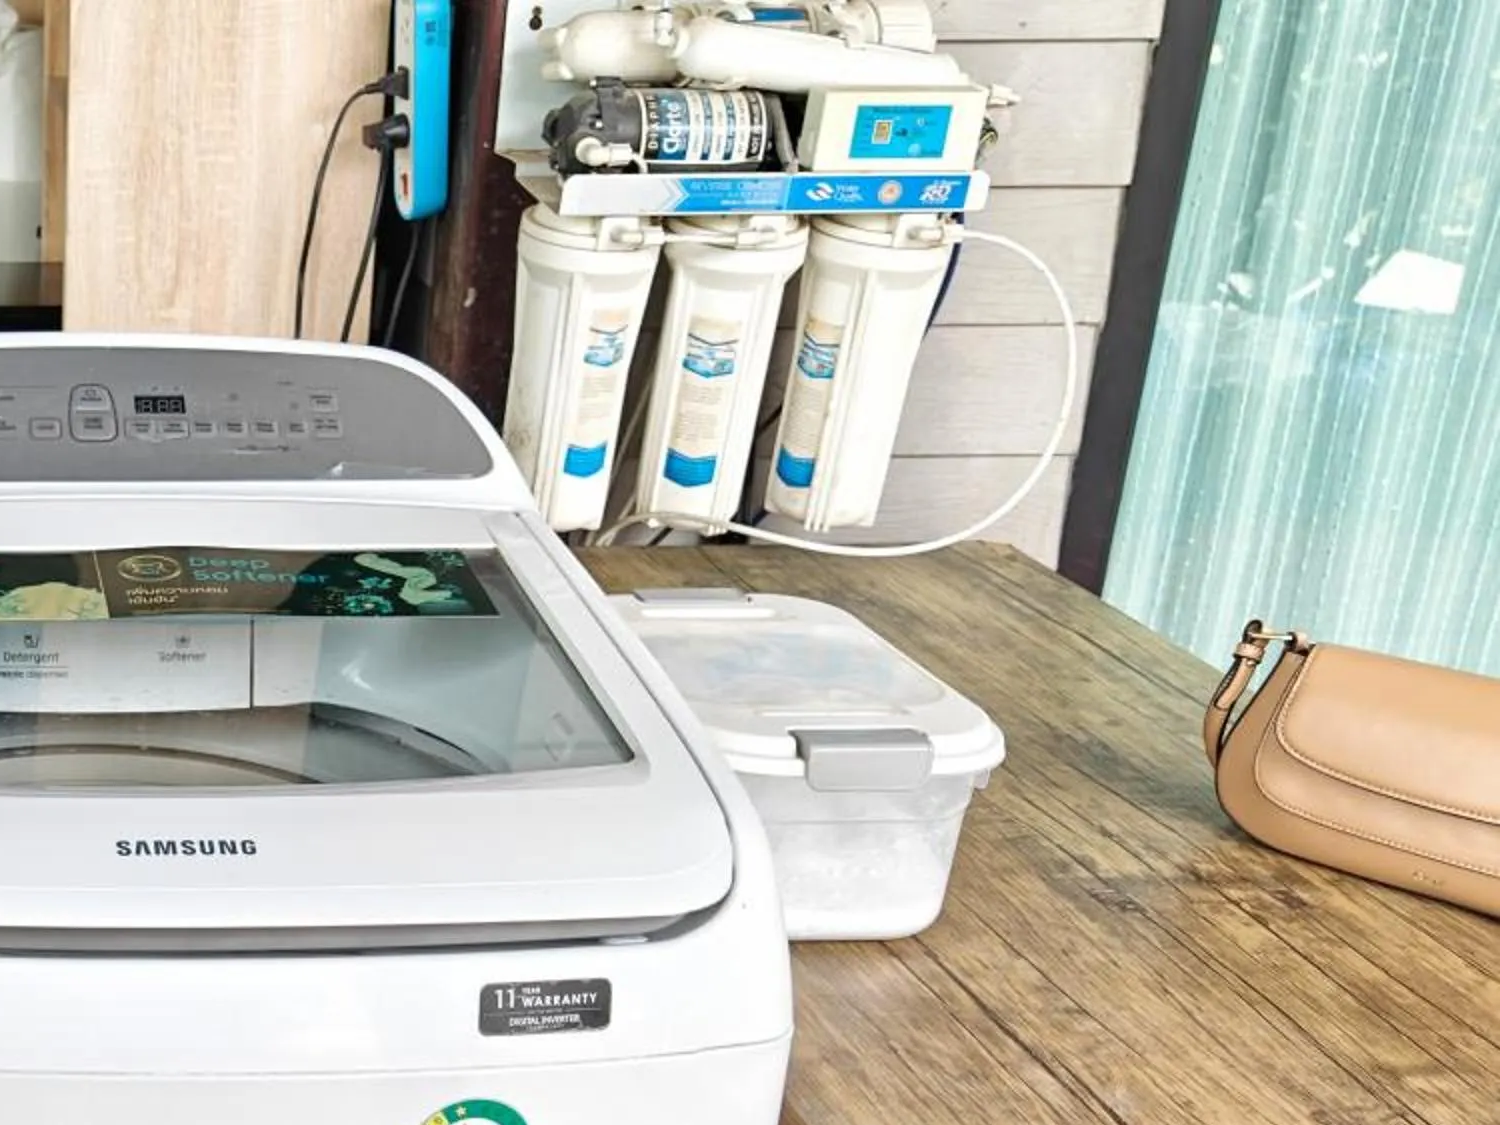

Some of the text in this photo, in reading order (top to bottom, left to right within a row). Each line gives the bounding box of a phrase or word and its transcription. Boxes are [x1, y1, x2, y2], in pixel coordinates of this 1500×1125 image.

[188, 556, 270, 570] Deep
[193, 570, 331, 584] Softener
[3, 651, 60, 664] Detergent
[115, 839, 258, 857] SAMSUNG
[494, 988, 516, 1009] 11
[521, 991, 598, 1009] WARRANTY
